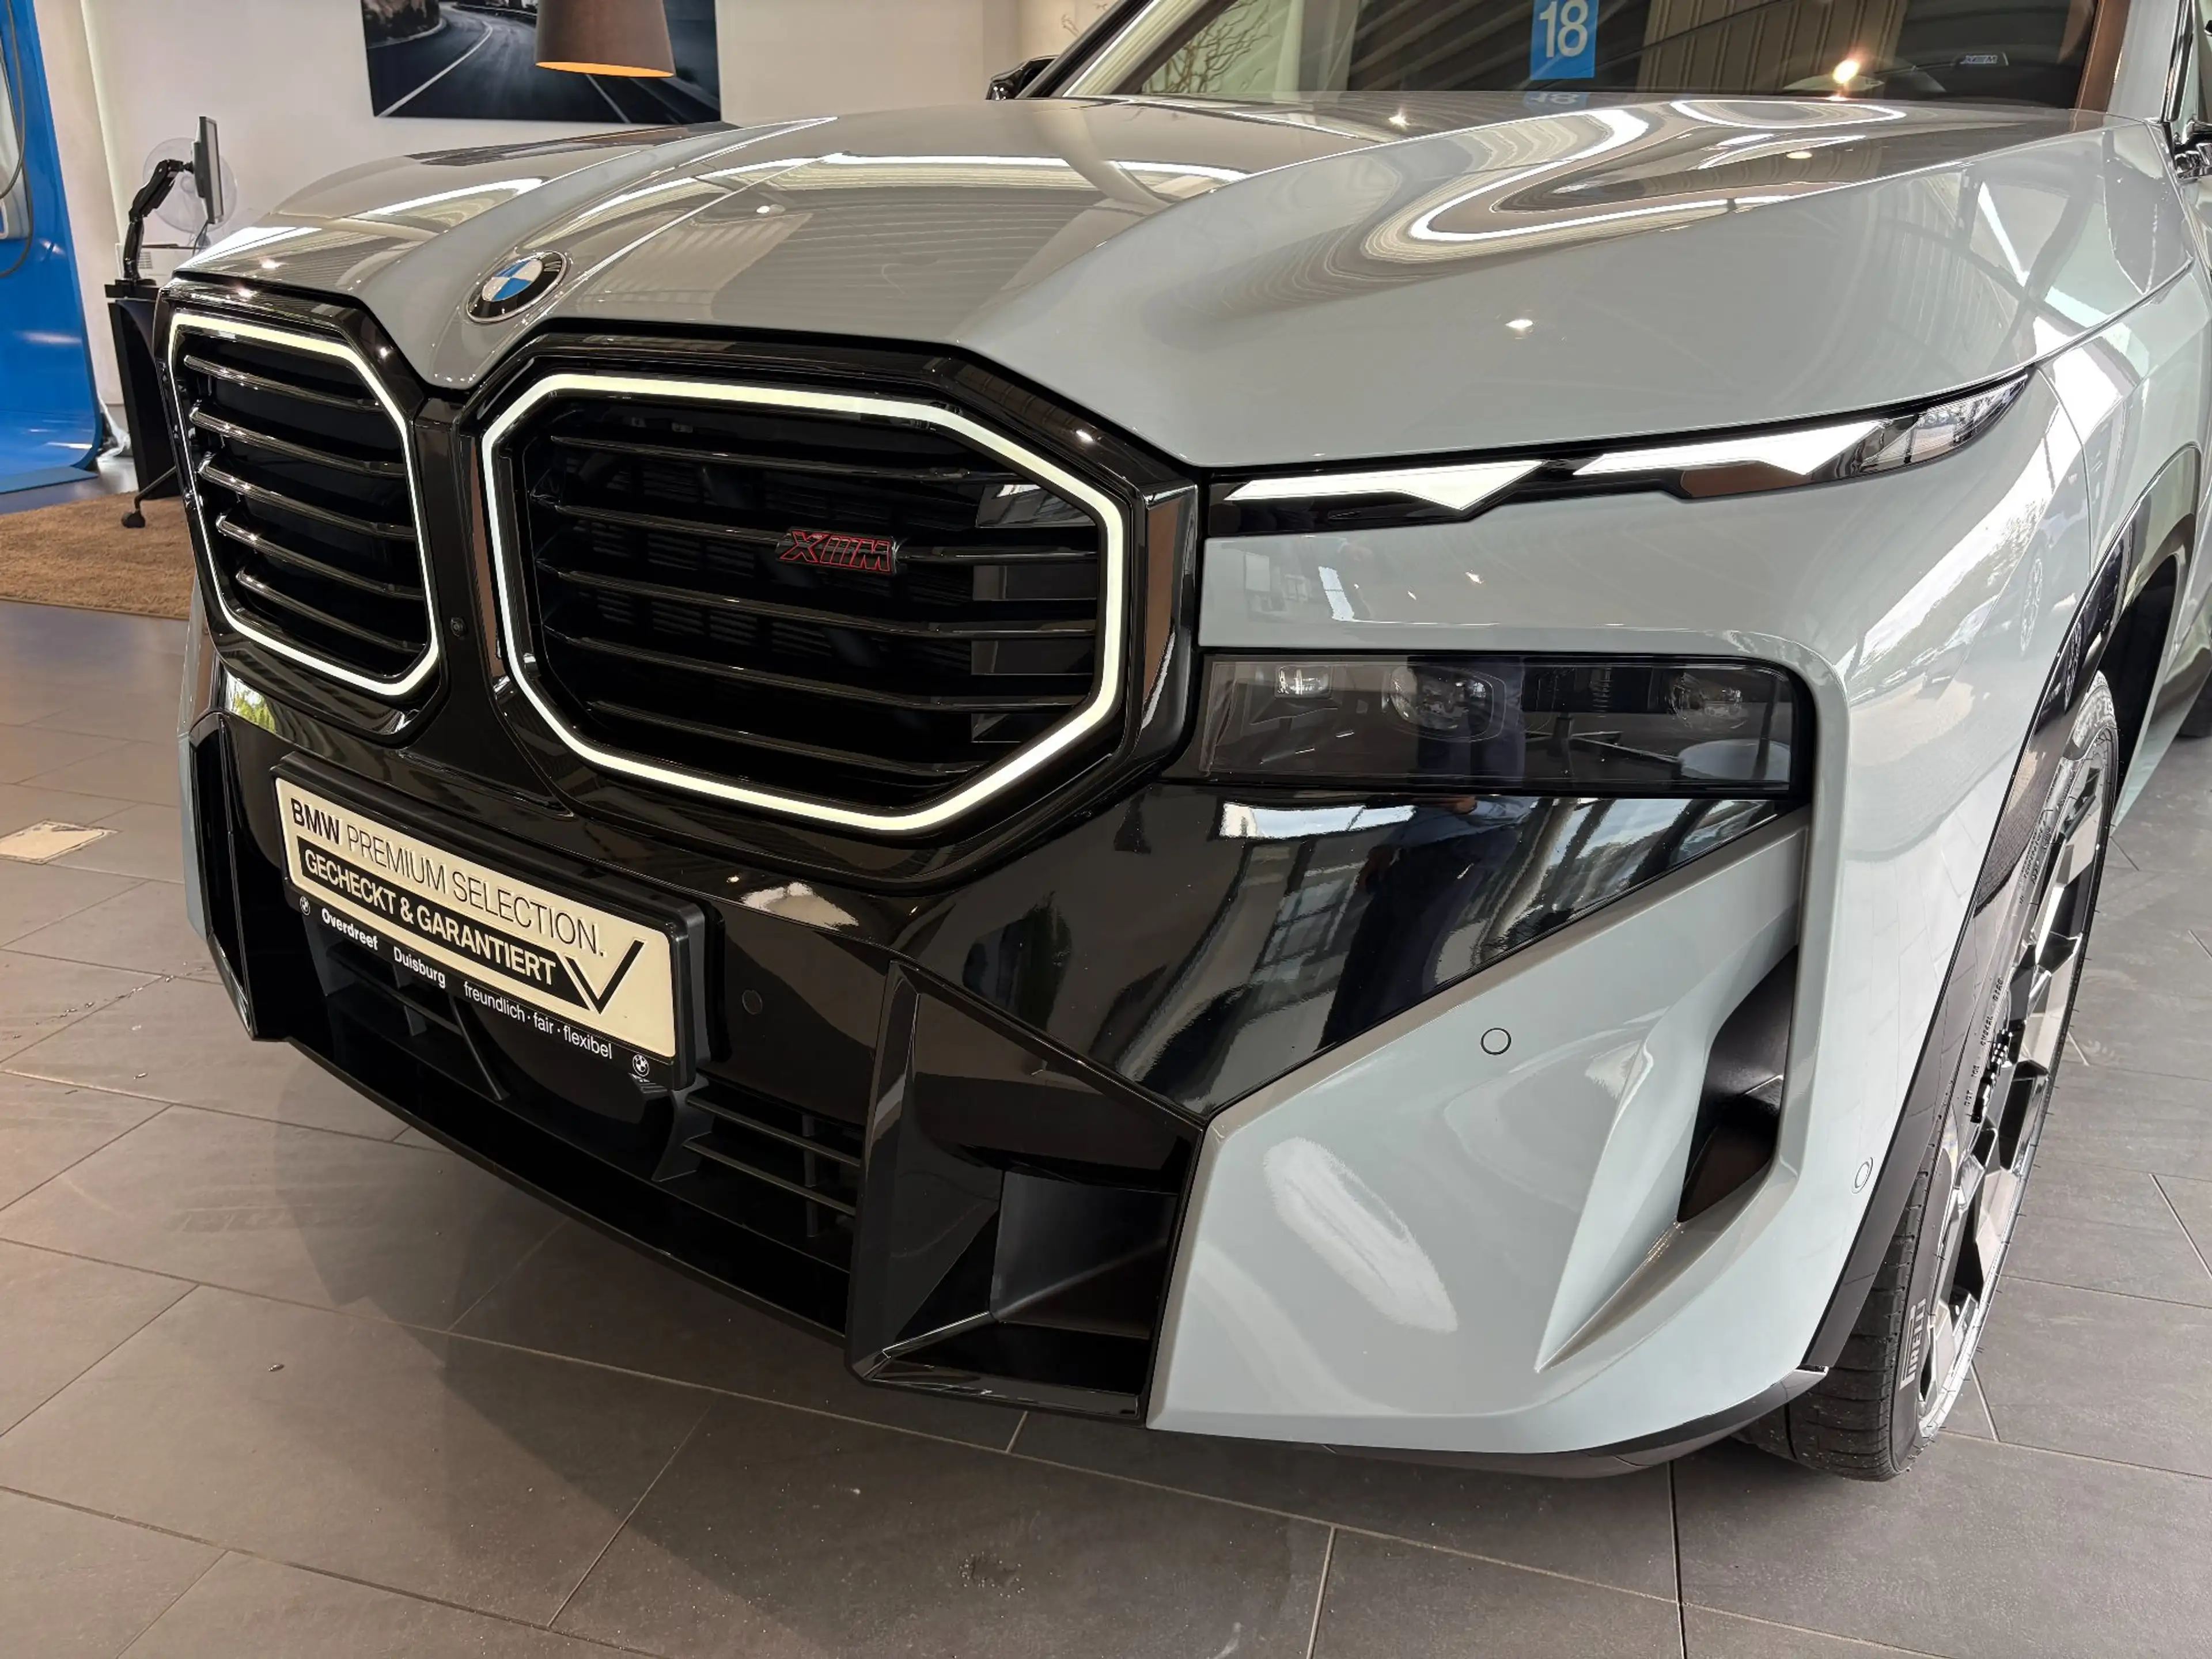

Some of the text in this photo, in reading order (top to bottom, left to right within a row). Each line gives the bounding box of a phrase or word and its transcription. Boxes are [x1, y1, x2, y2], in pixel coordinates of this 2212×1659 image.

[1539, 0, 1588, 58] 18
[291, 797, 605, 957] BMW PREMIUM SELECTION.
[305, 849, 556, 986] GECHECKT & GARANTIERT
[393, 945, 446, 989] Duisburg
[463, 980, 525, 1022] freundlich
[533, 1012, 554, 1035] fair
[563, 1025, 613, 1059] flexibel
[1899, 1297, 1927, 1391] PIRELLI
